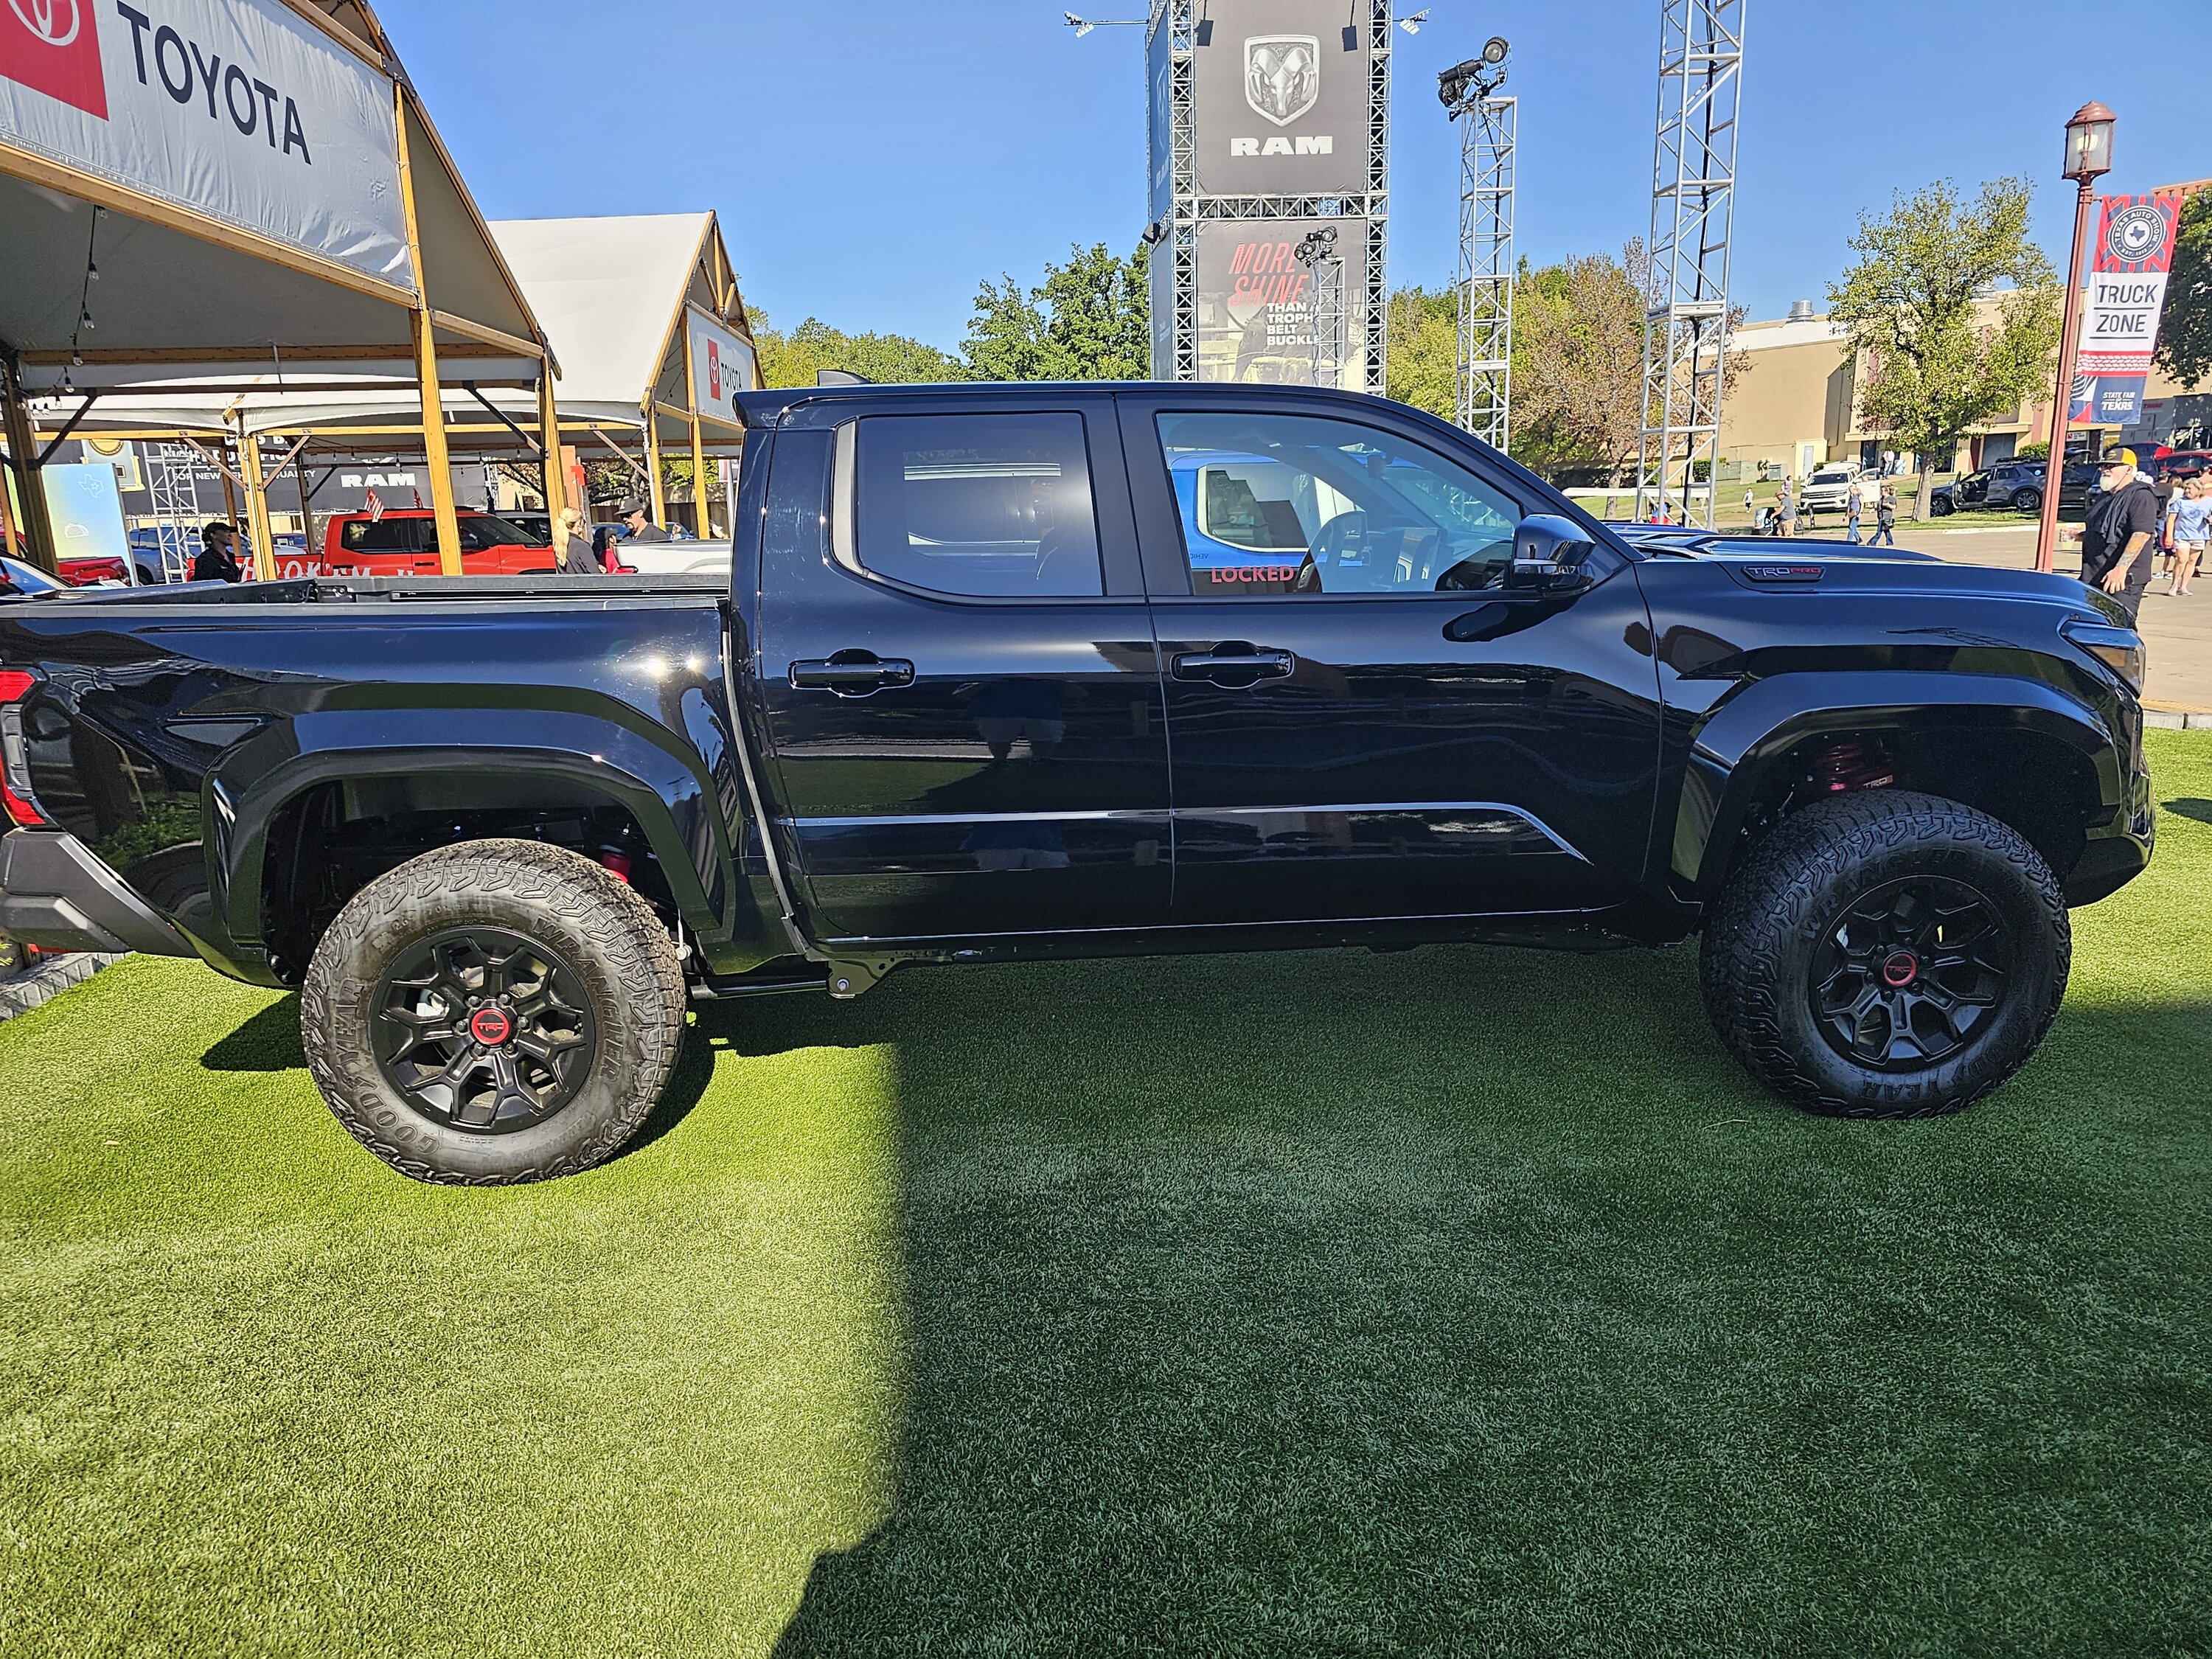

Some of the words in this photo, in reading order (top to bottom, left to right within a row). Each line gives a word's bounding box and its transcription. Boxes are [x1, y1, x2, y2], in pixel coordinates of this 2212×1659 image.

[116, 0, 312, 165] TOYOTA
[1230, 136, 1333, 157] RAM
[2115, 217, 2129, 243] TEXAS
[2131, 211, 2152, 219] AUTO
[2151, 218, 2160, 242] SHOW
[1228, 243, 1301, 274] MORE
[1230, 274, 1310, 307] SHINE
[2098, 284, 2159, 304] TRUCK
[1267, 302, 1307, 313] THAN
[1267, 313, 1318, 323] TROPH
[2096, 314, 2146, 333] ZONE
[1267, 324, 1298, 335] BELT
[720, 362, 742, 391] TOYOTA
[2101, 401, 2134, 411] TEXAS
[195, 472, 220, 480] NEW
[341, 473, 416, 487] RAM
[1211, 565, 1294, 583] LOCKED
[1748, 567, 1791, 577] TRD
[532, 916, 625, 1082] WRANGLER
[476, 1022, 505, 1032] TRD
